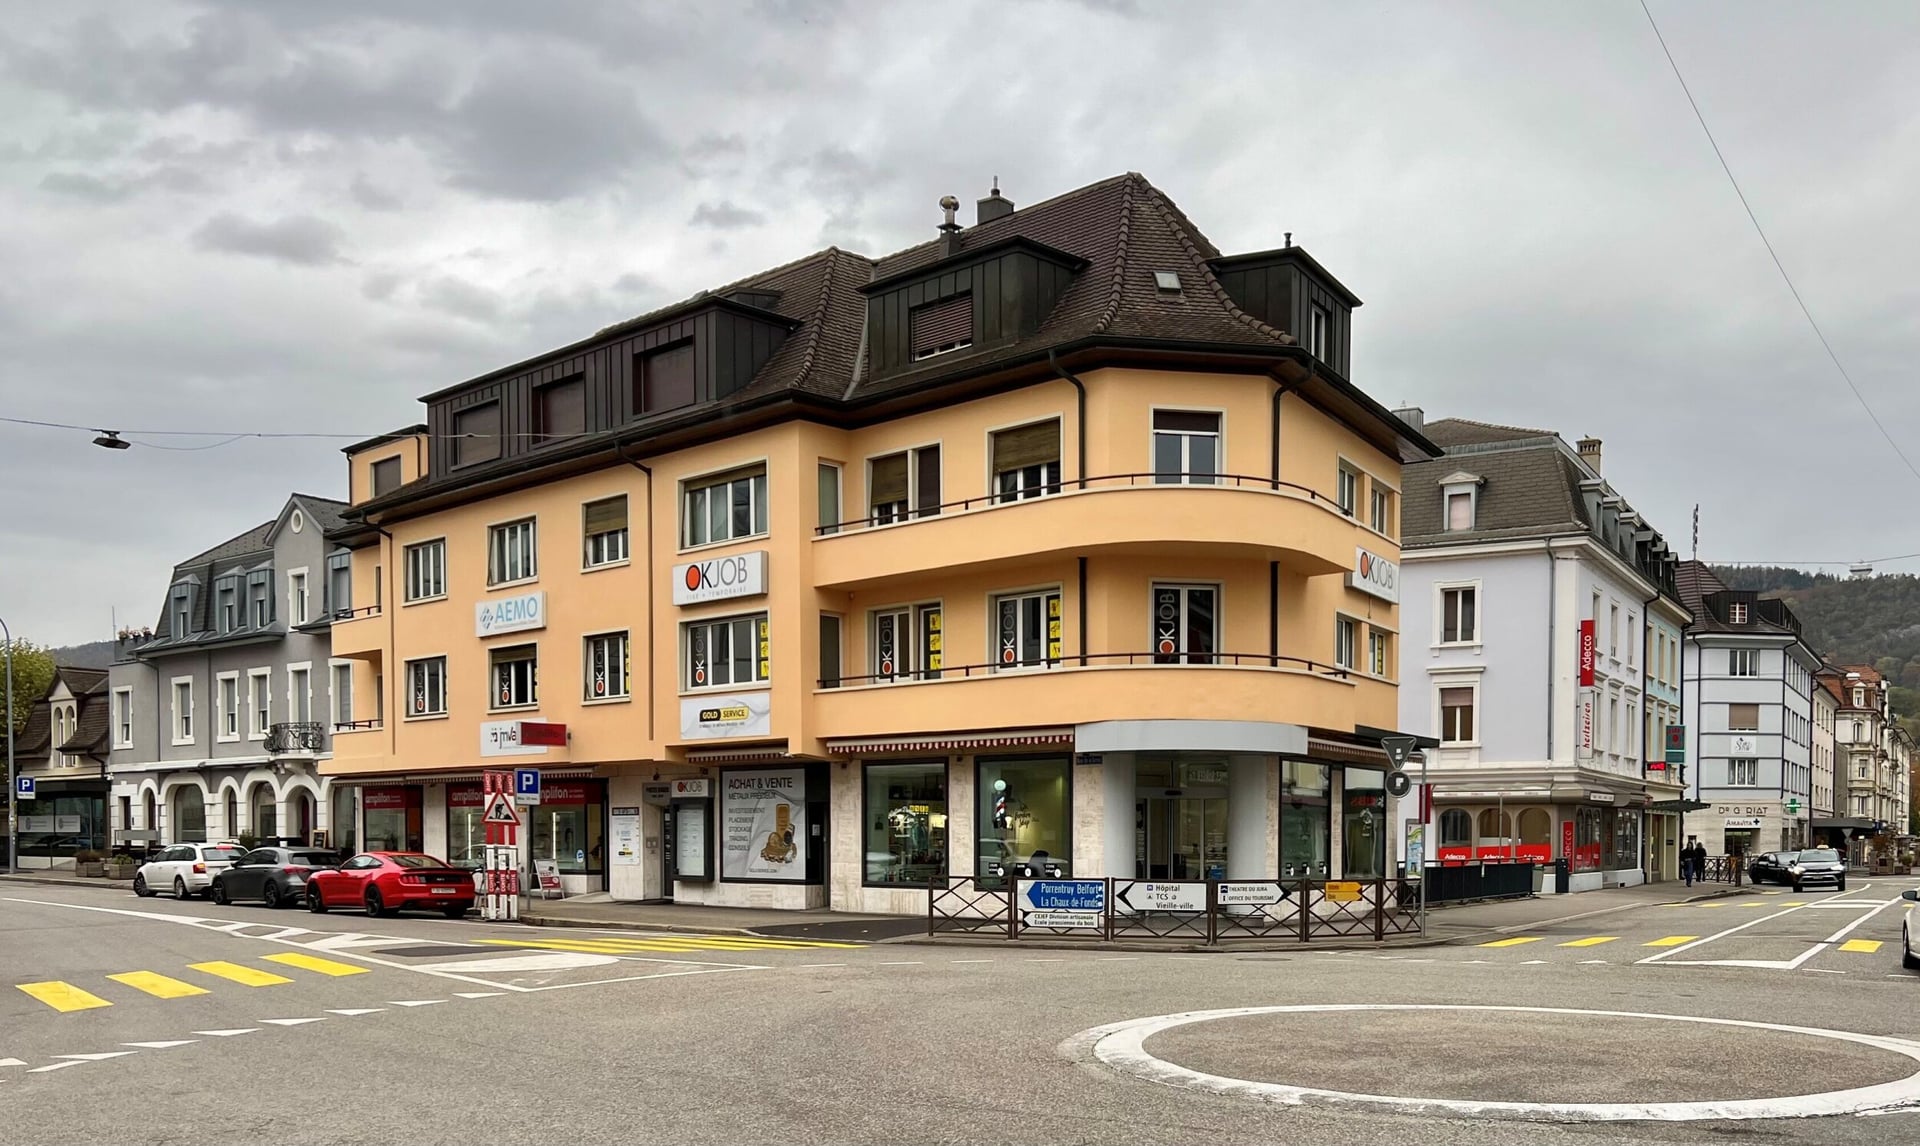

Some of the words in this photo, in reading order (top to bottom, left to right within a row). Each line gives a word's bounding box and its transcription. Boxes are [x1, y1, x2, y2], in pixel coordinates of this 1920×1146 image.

[685, 557, 748, 592] OKJOB
[1360, 551, 1393, 589] OKJOB
[495, 597, 538, 623] AEMO
[1003, 602, 1015, 663] OKJOB
[1159, 594, 1175, 655] OKJOB
[881, 619, 893, 675] OKJOB
[1581, 634, 1592, 671] Adecco
[702, 711, 718, 720] GOLD
[722, 709, 745, 718] SERVICE
[22, 780, 30, 791] P
[522, 774, 533, 791] P
[728, 778, 756, 790] ACHAT
[757, 778, 763, 789] &
[765, 777, 793, 789] VENTE
[451, 789, 484, 804] amplifon
[1564, 830, 1573, 857] decco
[1041, 883, 1074, 895] Porrentruy
[1077, 884, 1098, 894] Belfort
[1155, 884, 1180, 892] Hôpital
[1041, 897, 1049, 907] La
